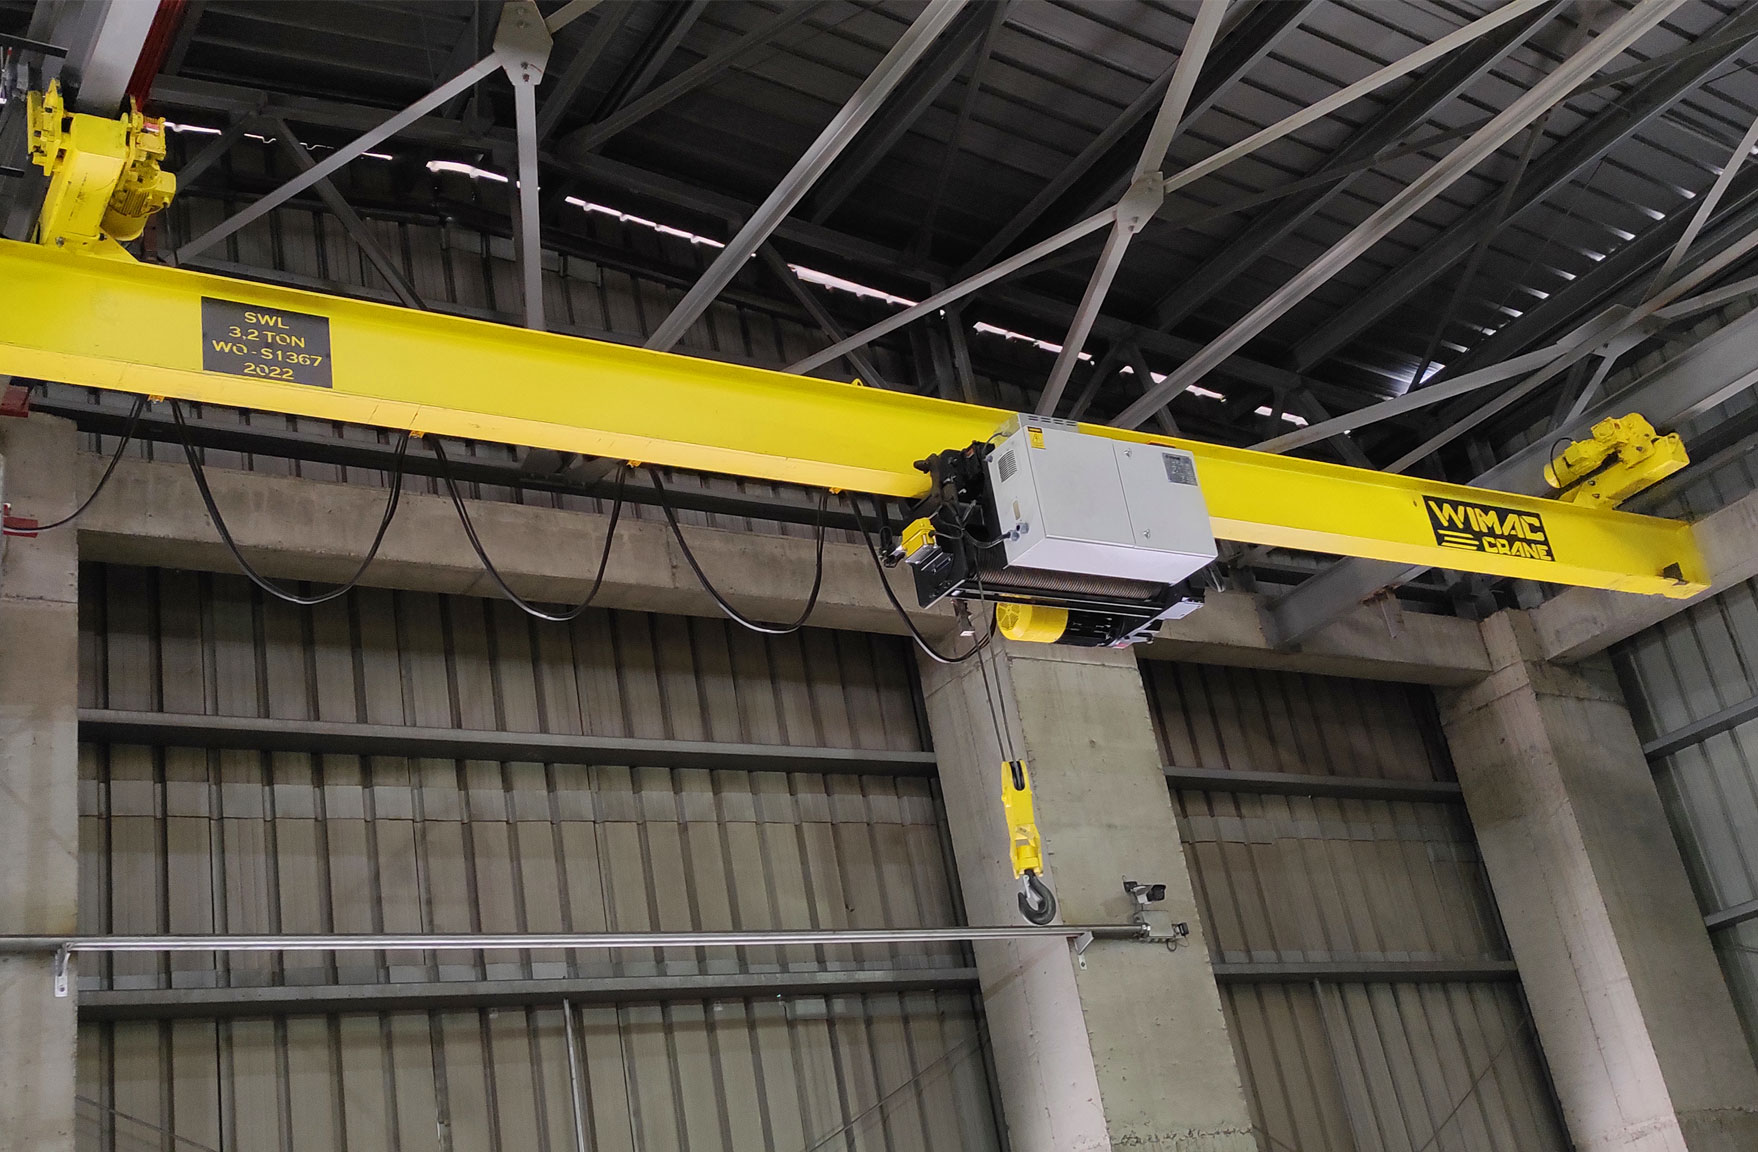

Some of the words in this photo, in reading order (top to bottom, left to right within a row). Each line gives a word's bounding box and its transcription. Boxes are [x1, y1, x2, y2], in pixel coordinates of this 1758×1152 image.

[244, 311, 290, 329] SWL
[262, 331, 305, 348] TON
[243, 362, 295, 380] 2022
[1427, 500, 1545, 541] WIMAC
[1481, 536, 1552, 561] CRANE
